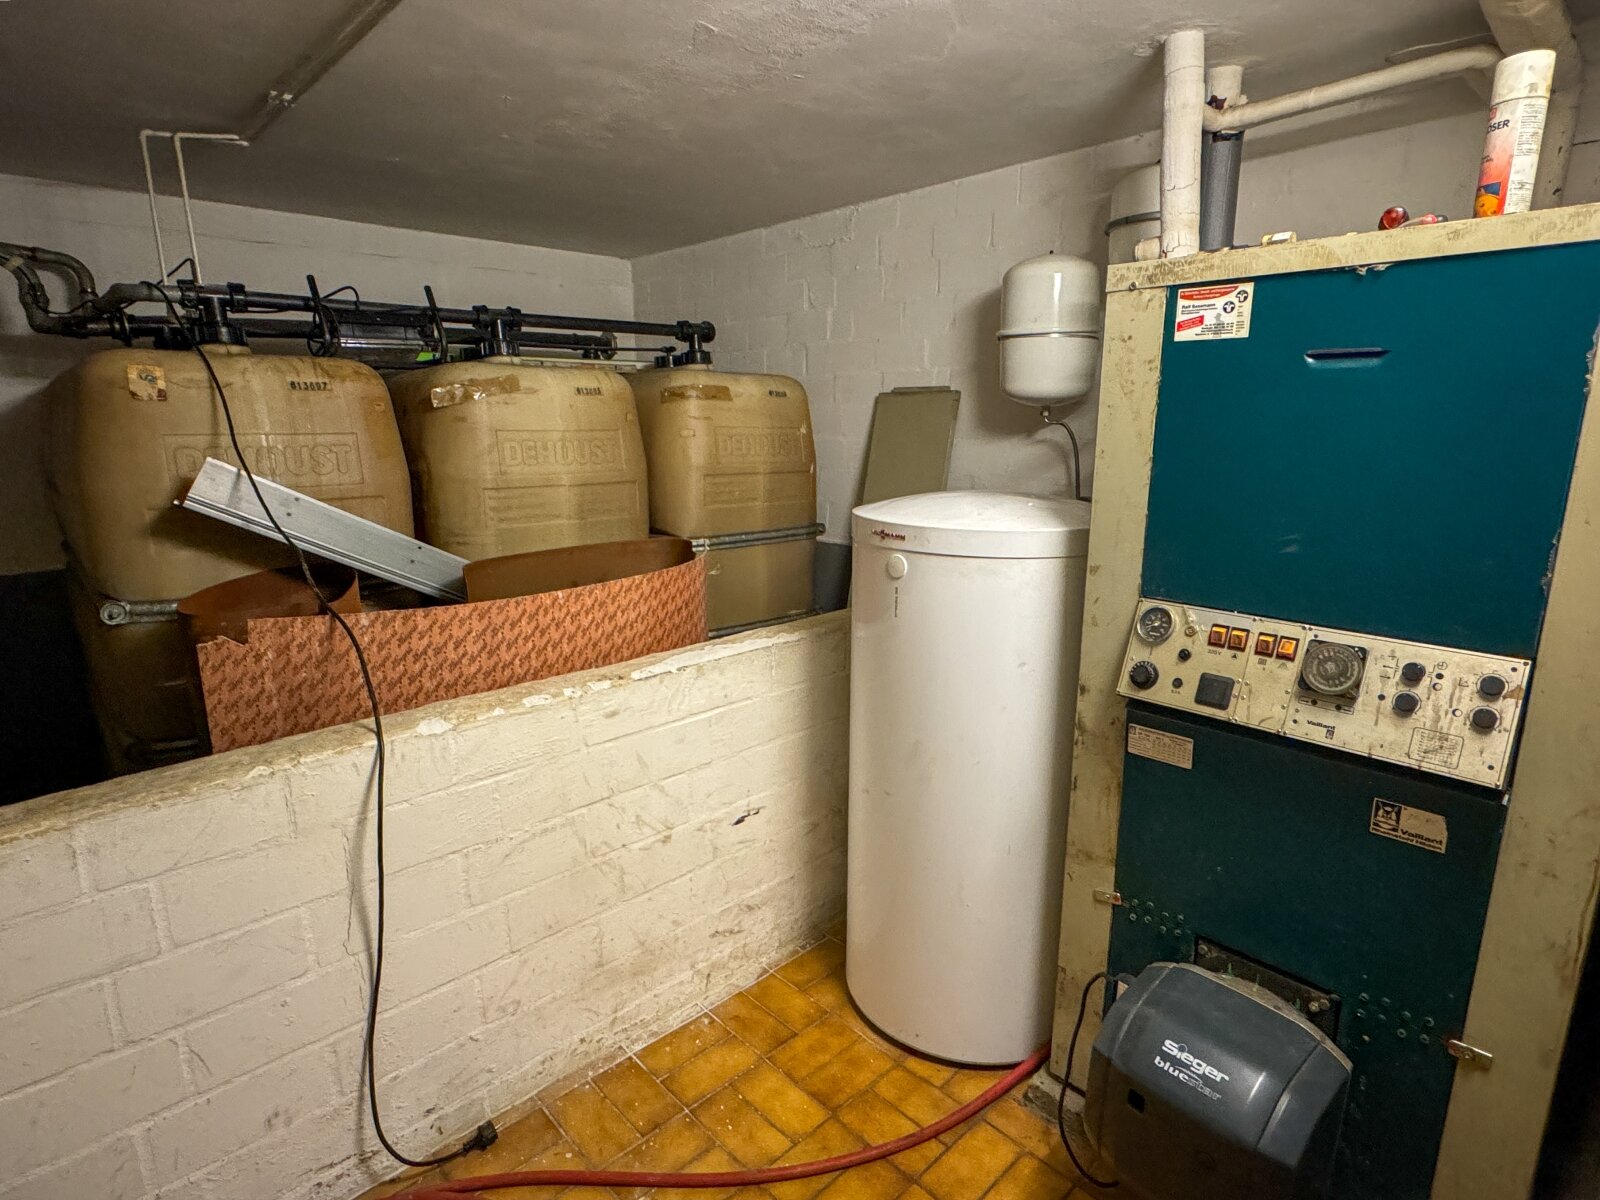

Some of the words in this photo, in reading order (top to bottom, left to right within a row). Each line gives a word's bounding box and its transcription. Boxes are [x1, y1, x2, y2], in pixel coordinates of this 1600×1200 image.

[174, 444, 353, 479] DOUST
[502, 438, 616, 467] DEHOUST
[1306, 719, 1336, 730] Vaillant
[1400, 828, 1444, 846] Vaillant
[1162, 1039, 1230, 1082] Sieger
[1154, 1056, 1222, 1100] bluestar
